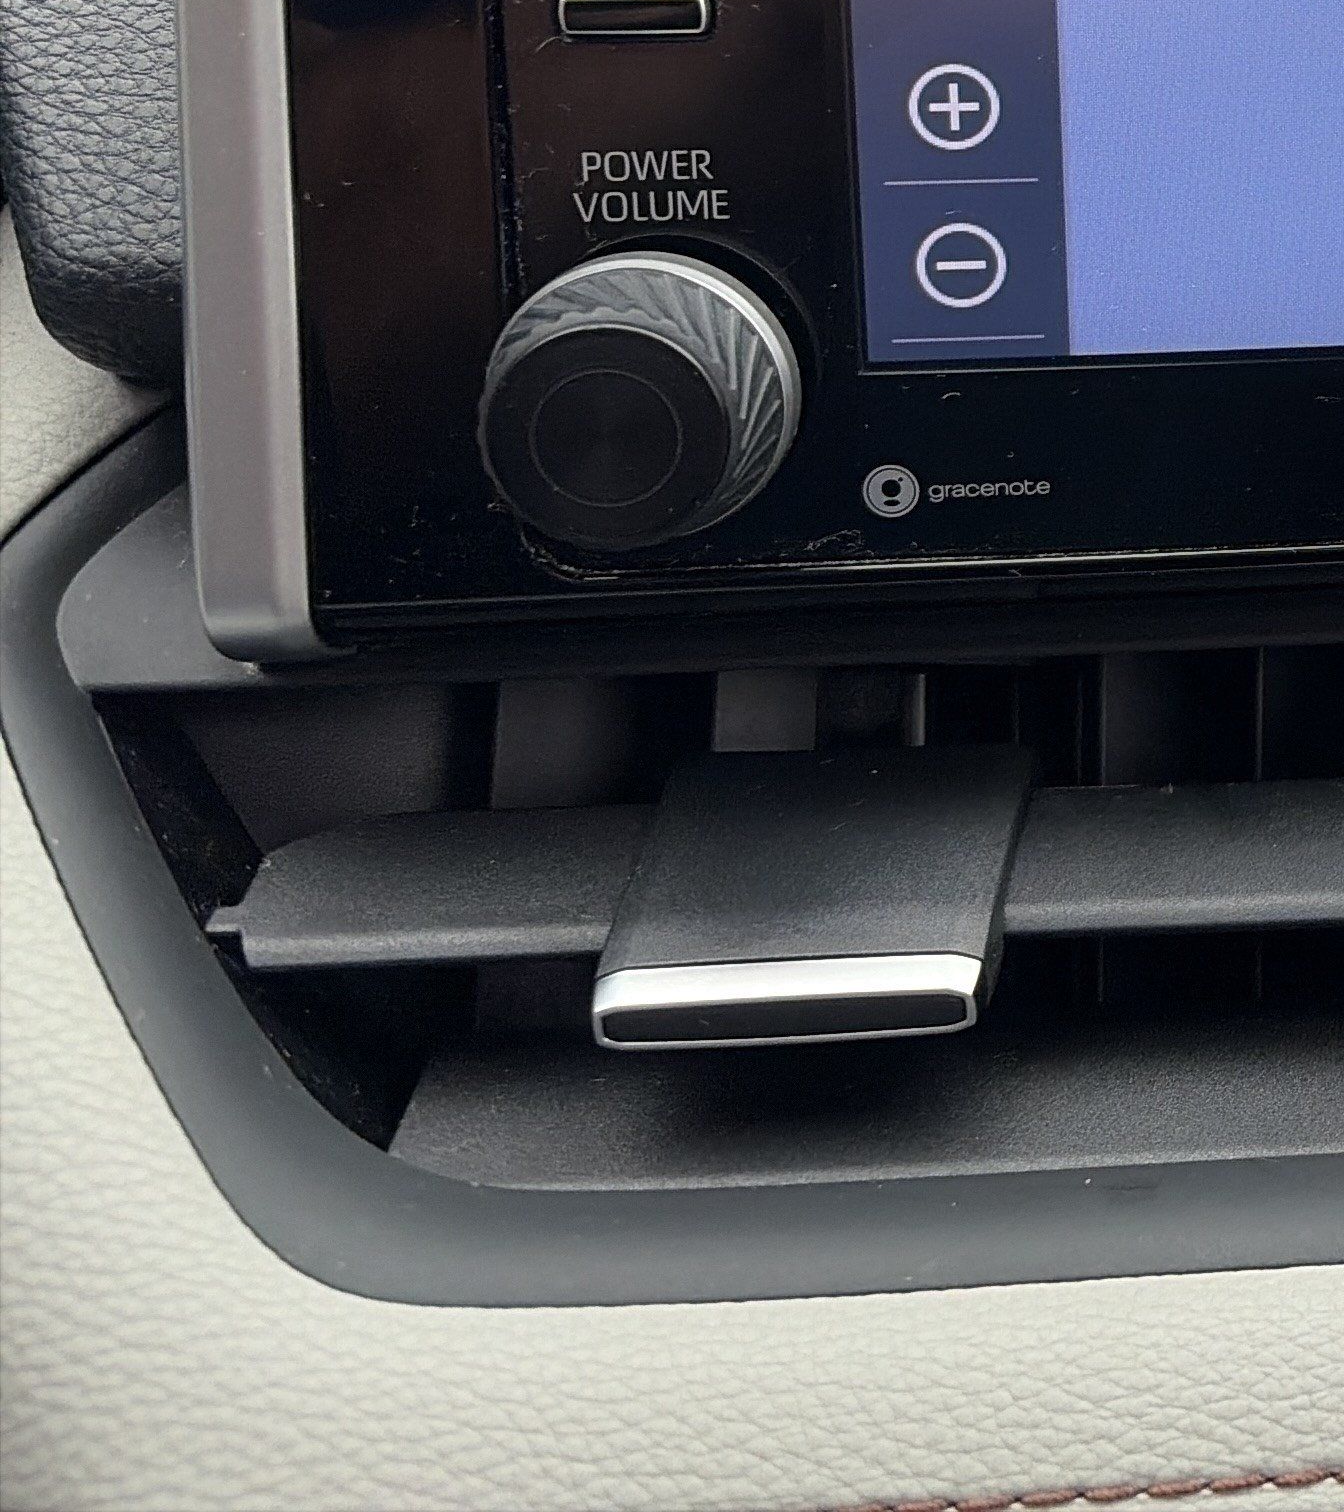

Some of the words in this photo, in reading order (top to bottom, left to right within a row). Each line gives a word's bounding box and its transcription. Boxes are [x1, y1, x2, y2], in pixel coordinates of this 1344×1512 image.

[580, 148, 714, 183] POWER
[571, 190, 732, 224] VOLUME
[928, 477, 1052, 503] gracenote
